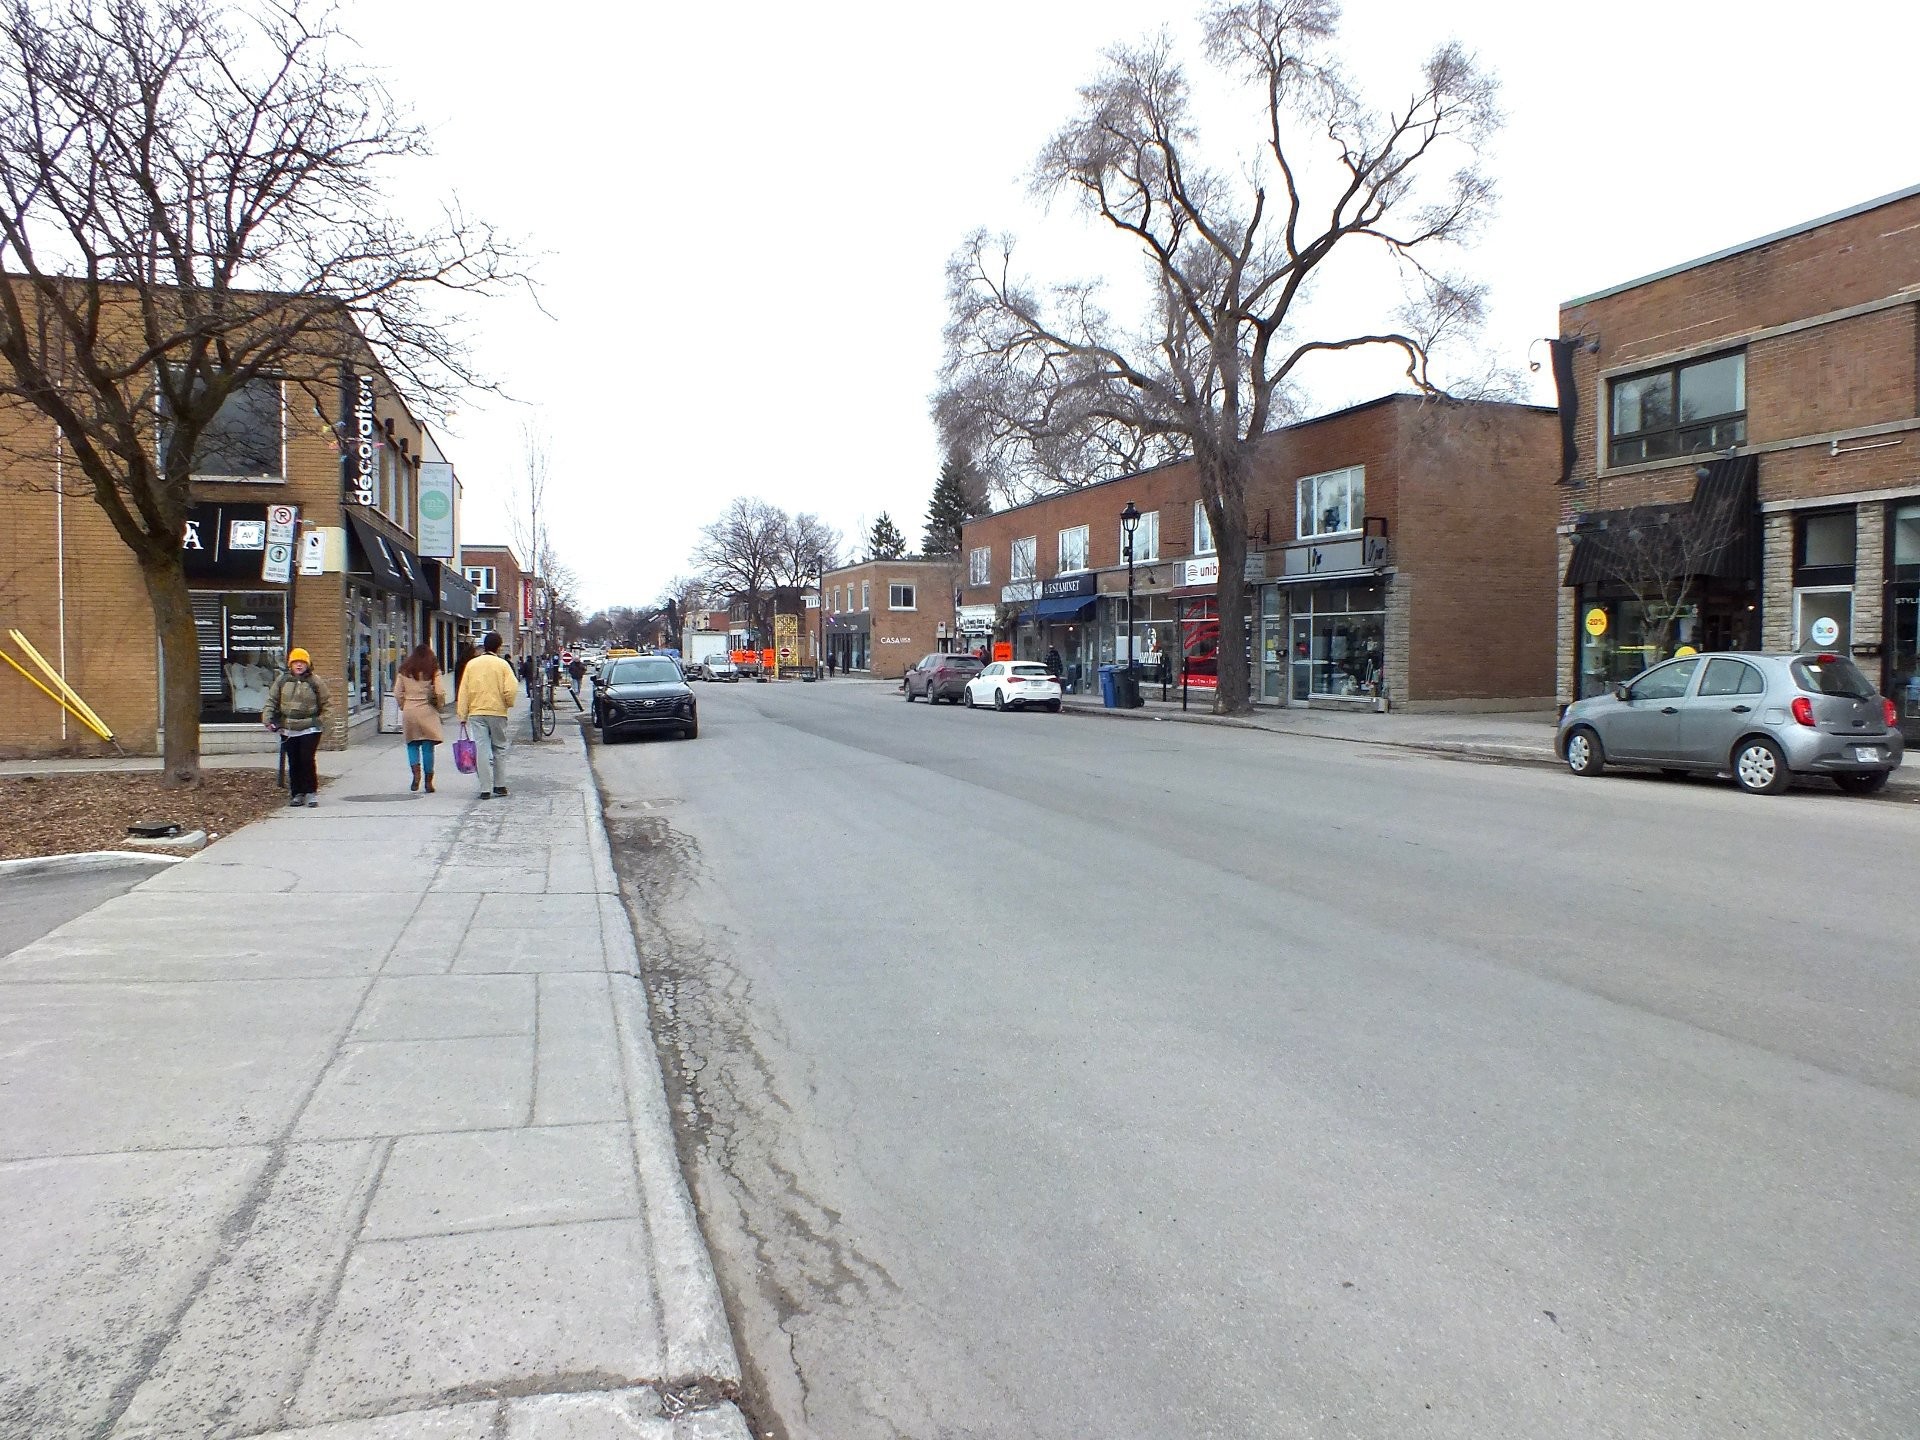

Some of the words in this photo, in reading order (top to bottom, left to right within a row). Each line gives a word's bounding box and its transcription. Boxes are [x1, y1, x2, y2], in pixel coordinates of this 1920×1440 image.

[355, 375, 373, 506] décoration
[1200, 563, 1219, 577] unib
[880, 636, 900, 644] CASA
